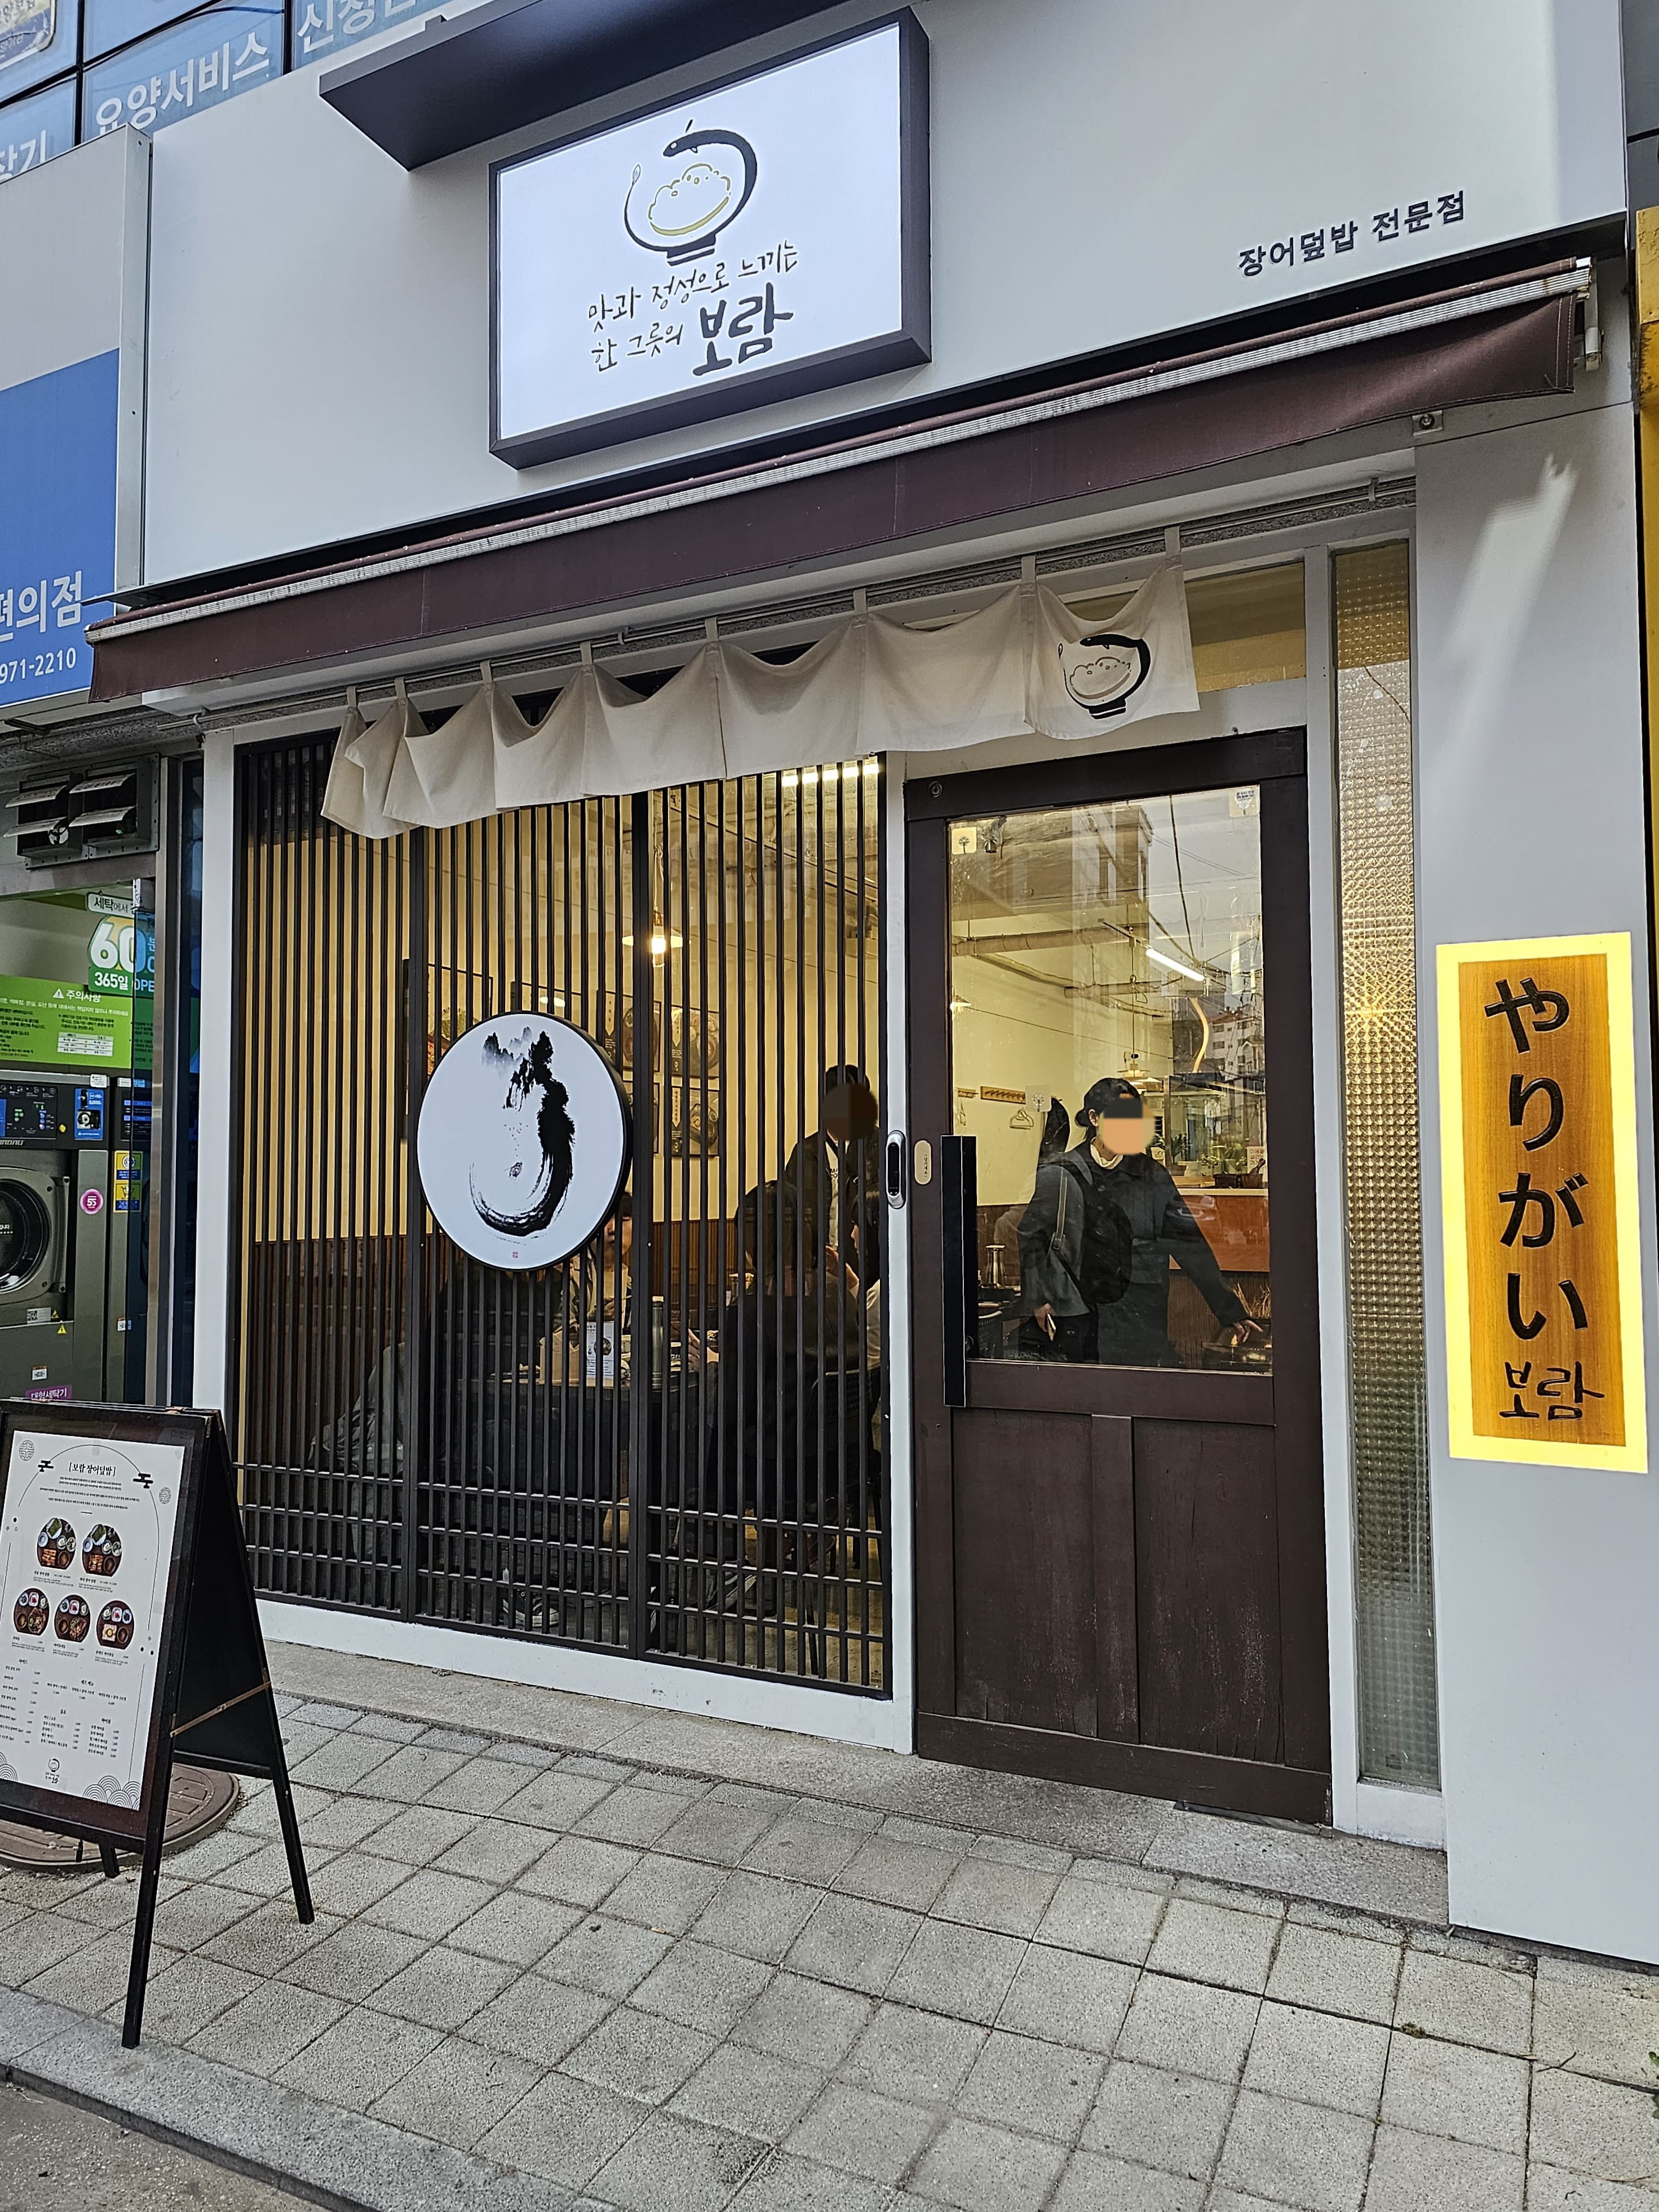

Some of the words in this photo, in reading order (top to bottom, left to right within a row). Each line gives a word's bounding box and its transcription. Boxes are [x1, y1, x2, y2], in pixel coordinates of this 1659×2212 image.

[96, 32, 270, 136] 요양서비스
[1239, 220, 1358, 277] 장어덮밥
[1372, 190, 1464, 242] 전문점
[589, 286, 642, 332] 맛과
[652, 262, 729, 309] 정성으로
[738, 240, 798, 277] 느끼는
[591, 338, 617, 372] 한
[627, 322, 683, 357] 그릇의
[692, 282, 794, 376] 보람
[94, 897, 128, 913] 세탁에서
[66, 990, 101, 1003] 주의사항
[94, 972, 129, 991] 365일
[1484, 977, 1589, 1341] やりがい
[1499, 1360, 1605, 1421] 보람
